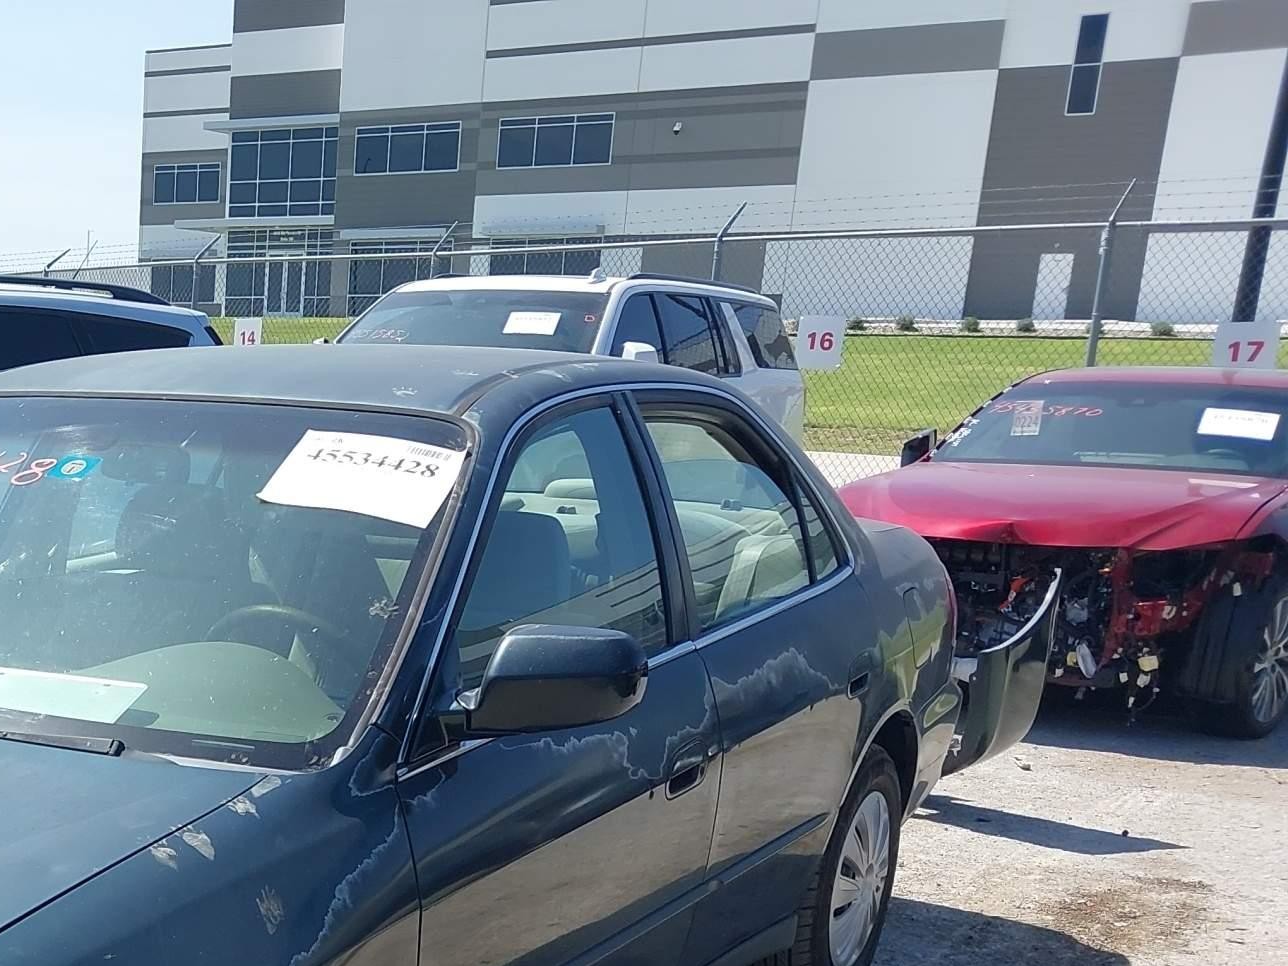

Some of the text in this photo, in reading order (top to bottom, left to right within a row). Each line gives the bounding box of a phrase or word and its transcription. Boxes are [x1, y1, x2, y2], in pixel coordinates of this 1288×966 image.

[240, 330, 256, 346] 14
[807, 331, 834, 351] 16
[1227, 341, 1265, 362] 17
[306, 447, 441, 479] 45534428
